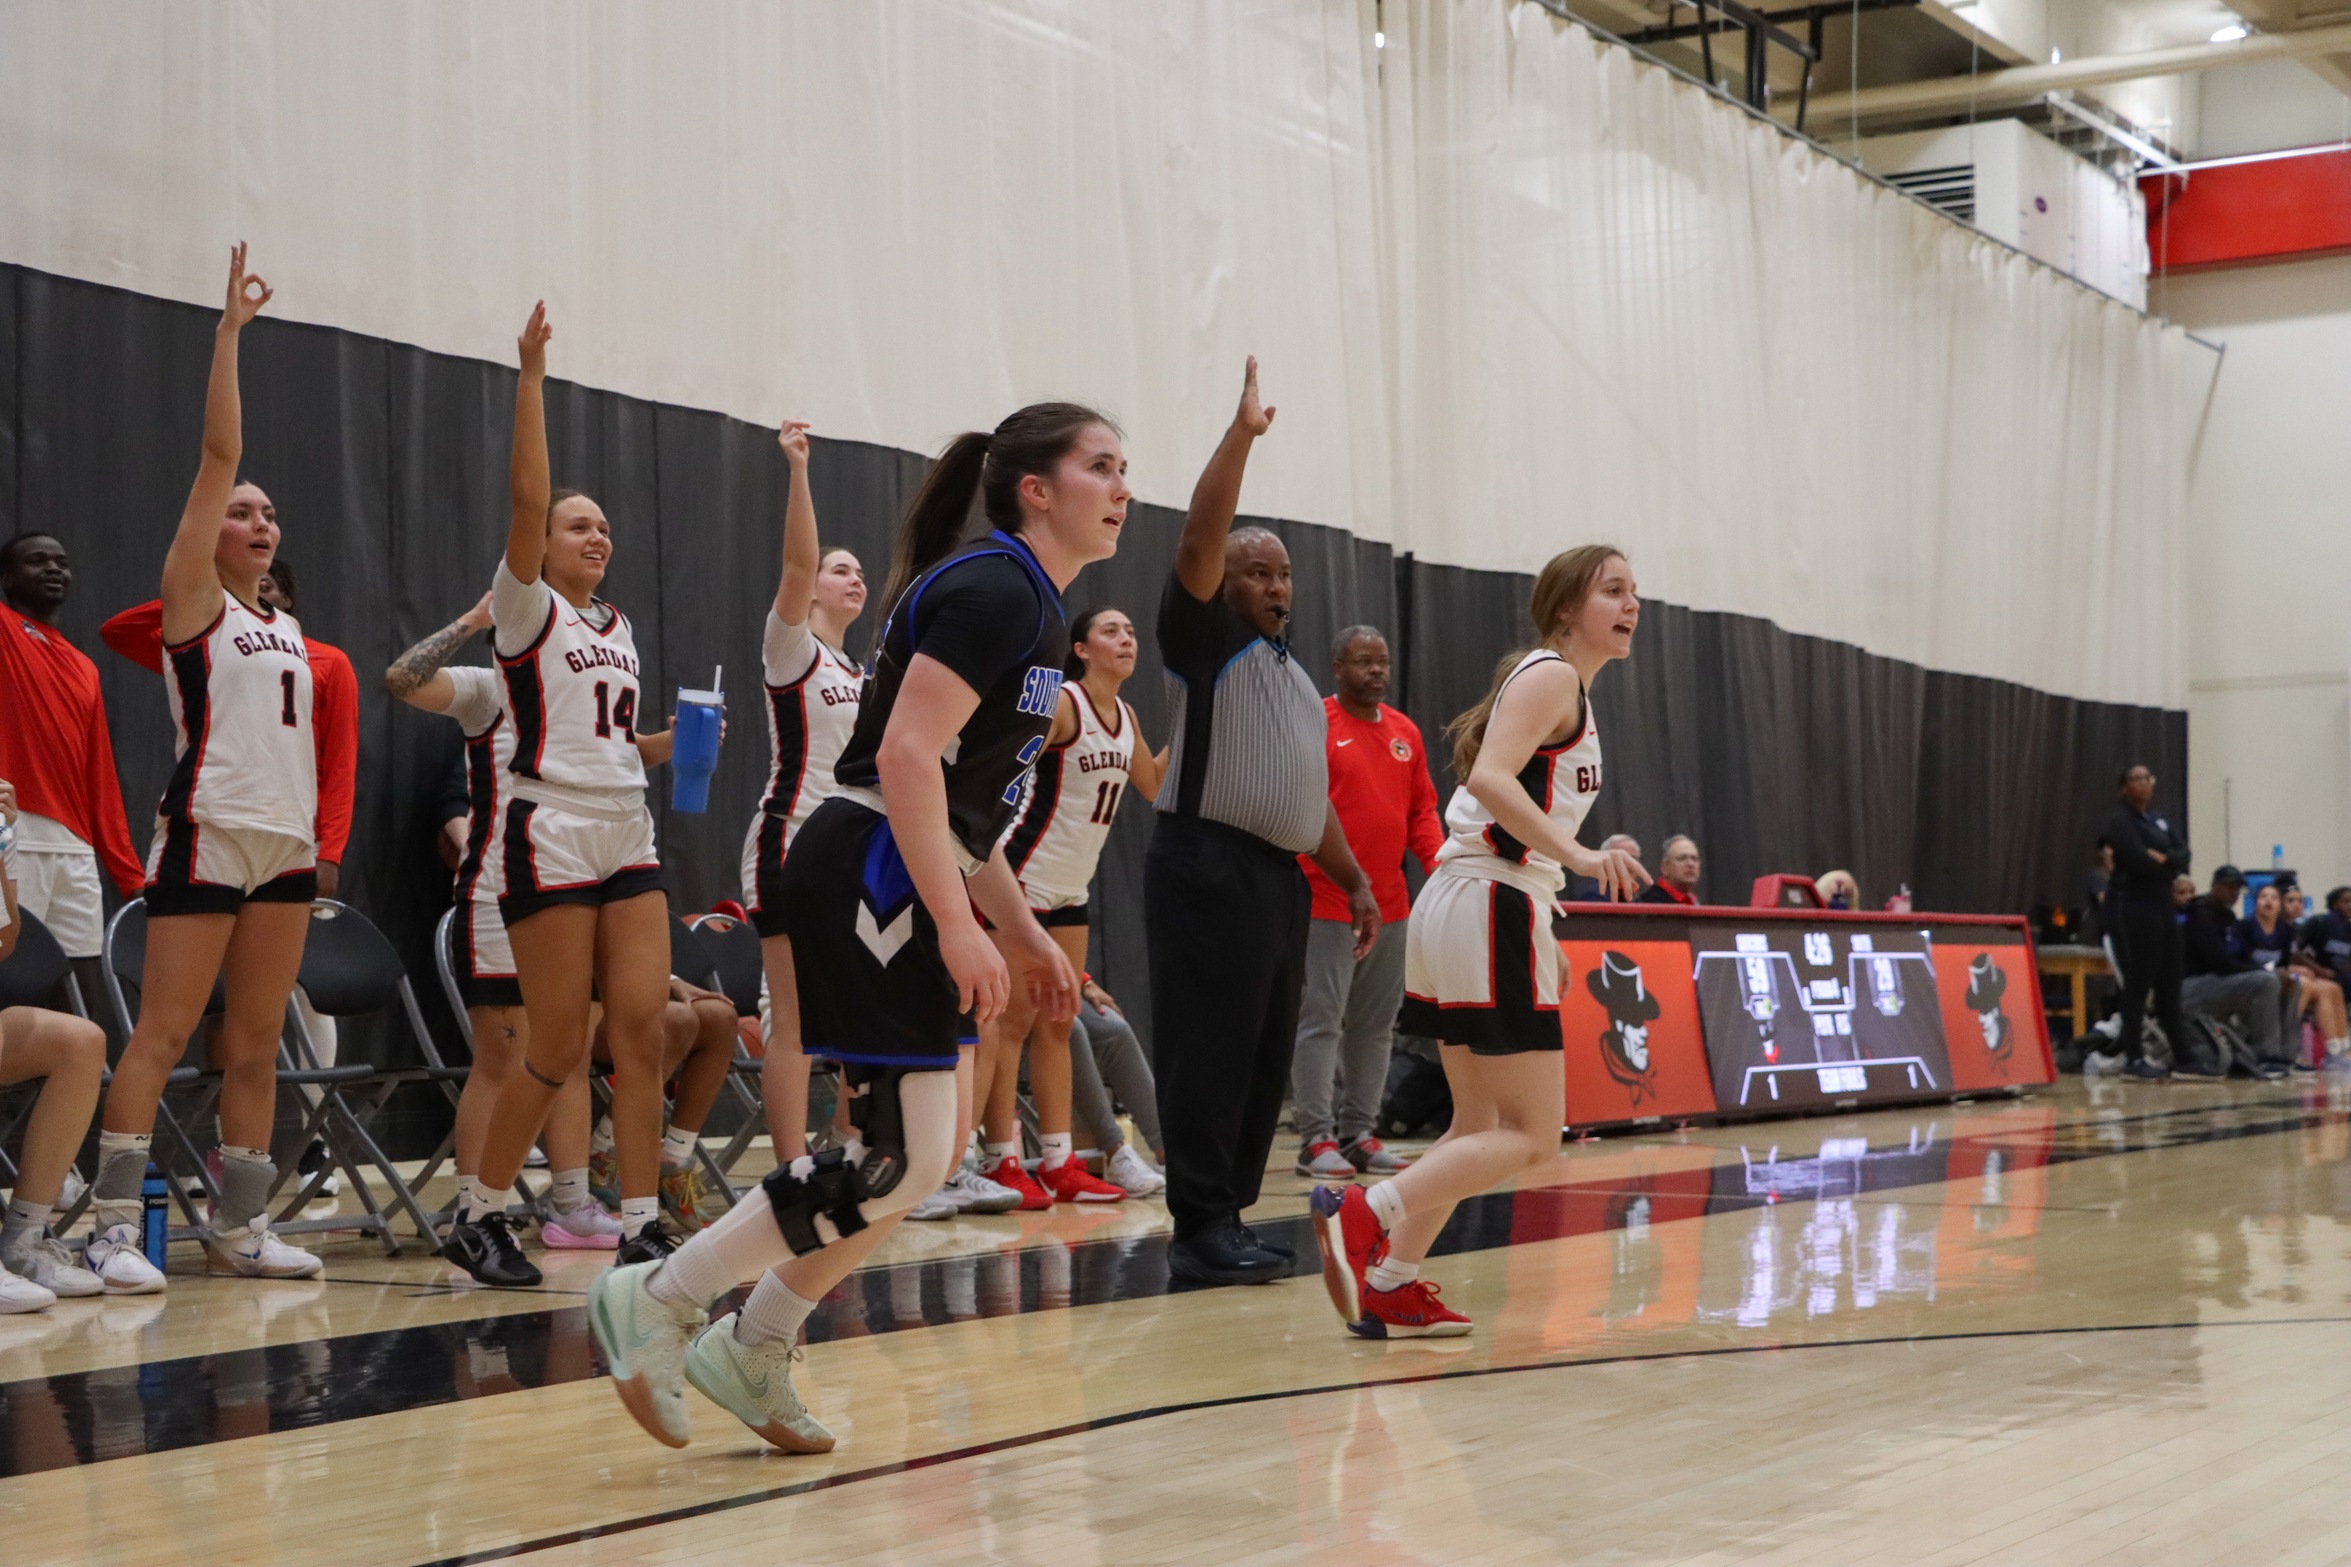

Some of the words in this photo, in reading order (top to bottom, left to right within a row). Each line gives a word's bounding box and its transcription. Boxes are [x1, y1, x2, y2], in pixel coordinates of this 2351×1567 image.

[281, 669, 297, 728] 1
[594, 680, 636, 745] 14
[1090, 780, 1121, 826] 11
